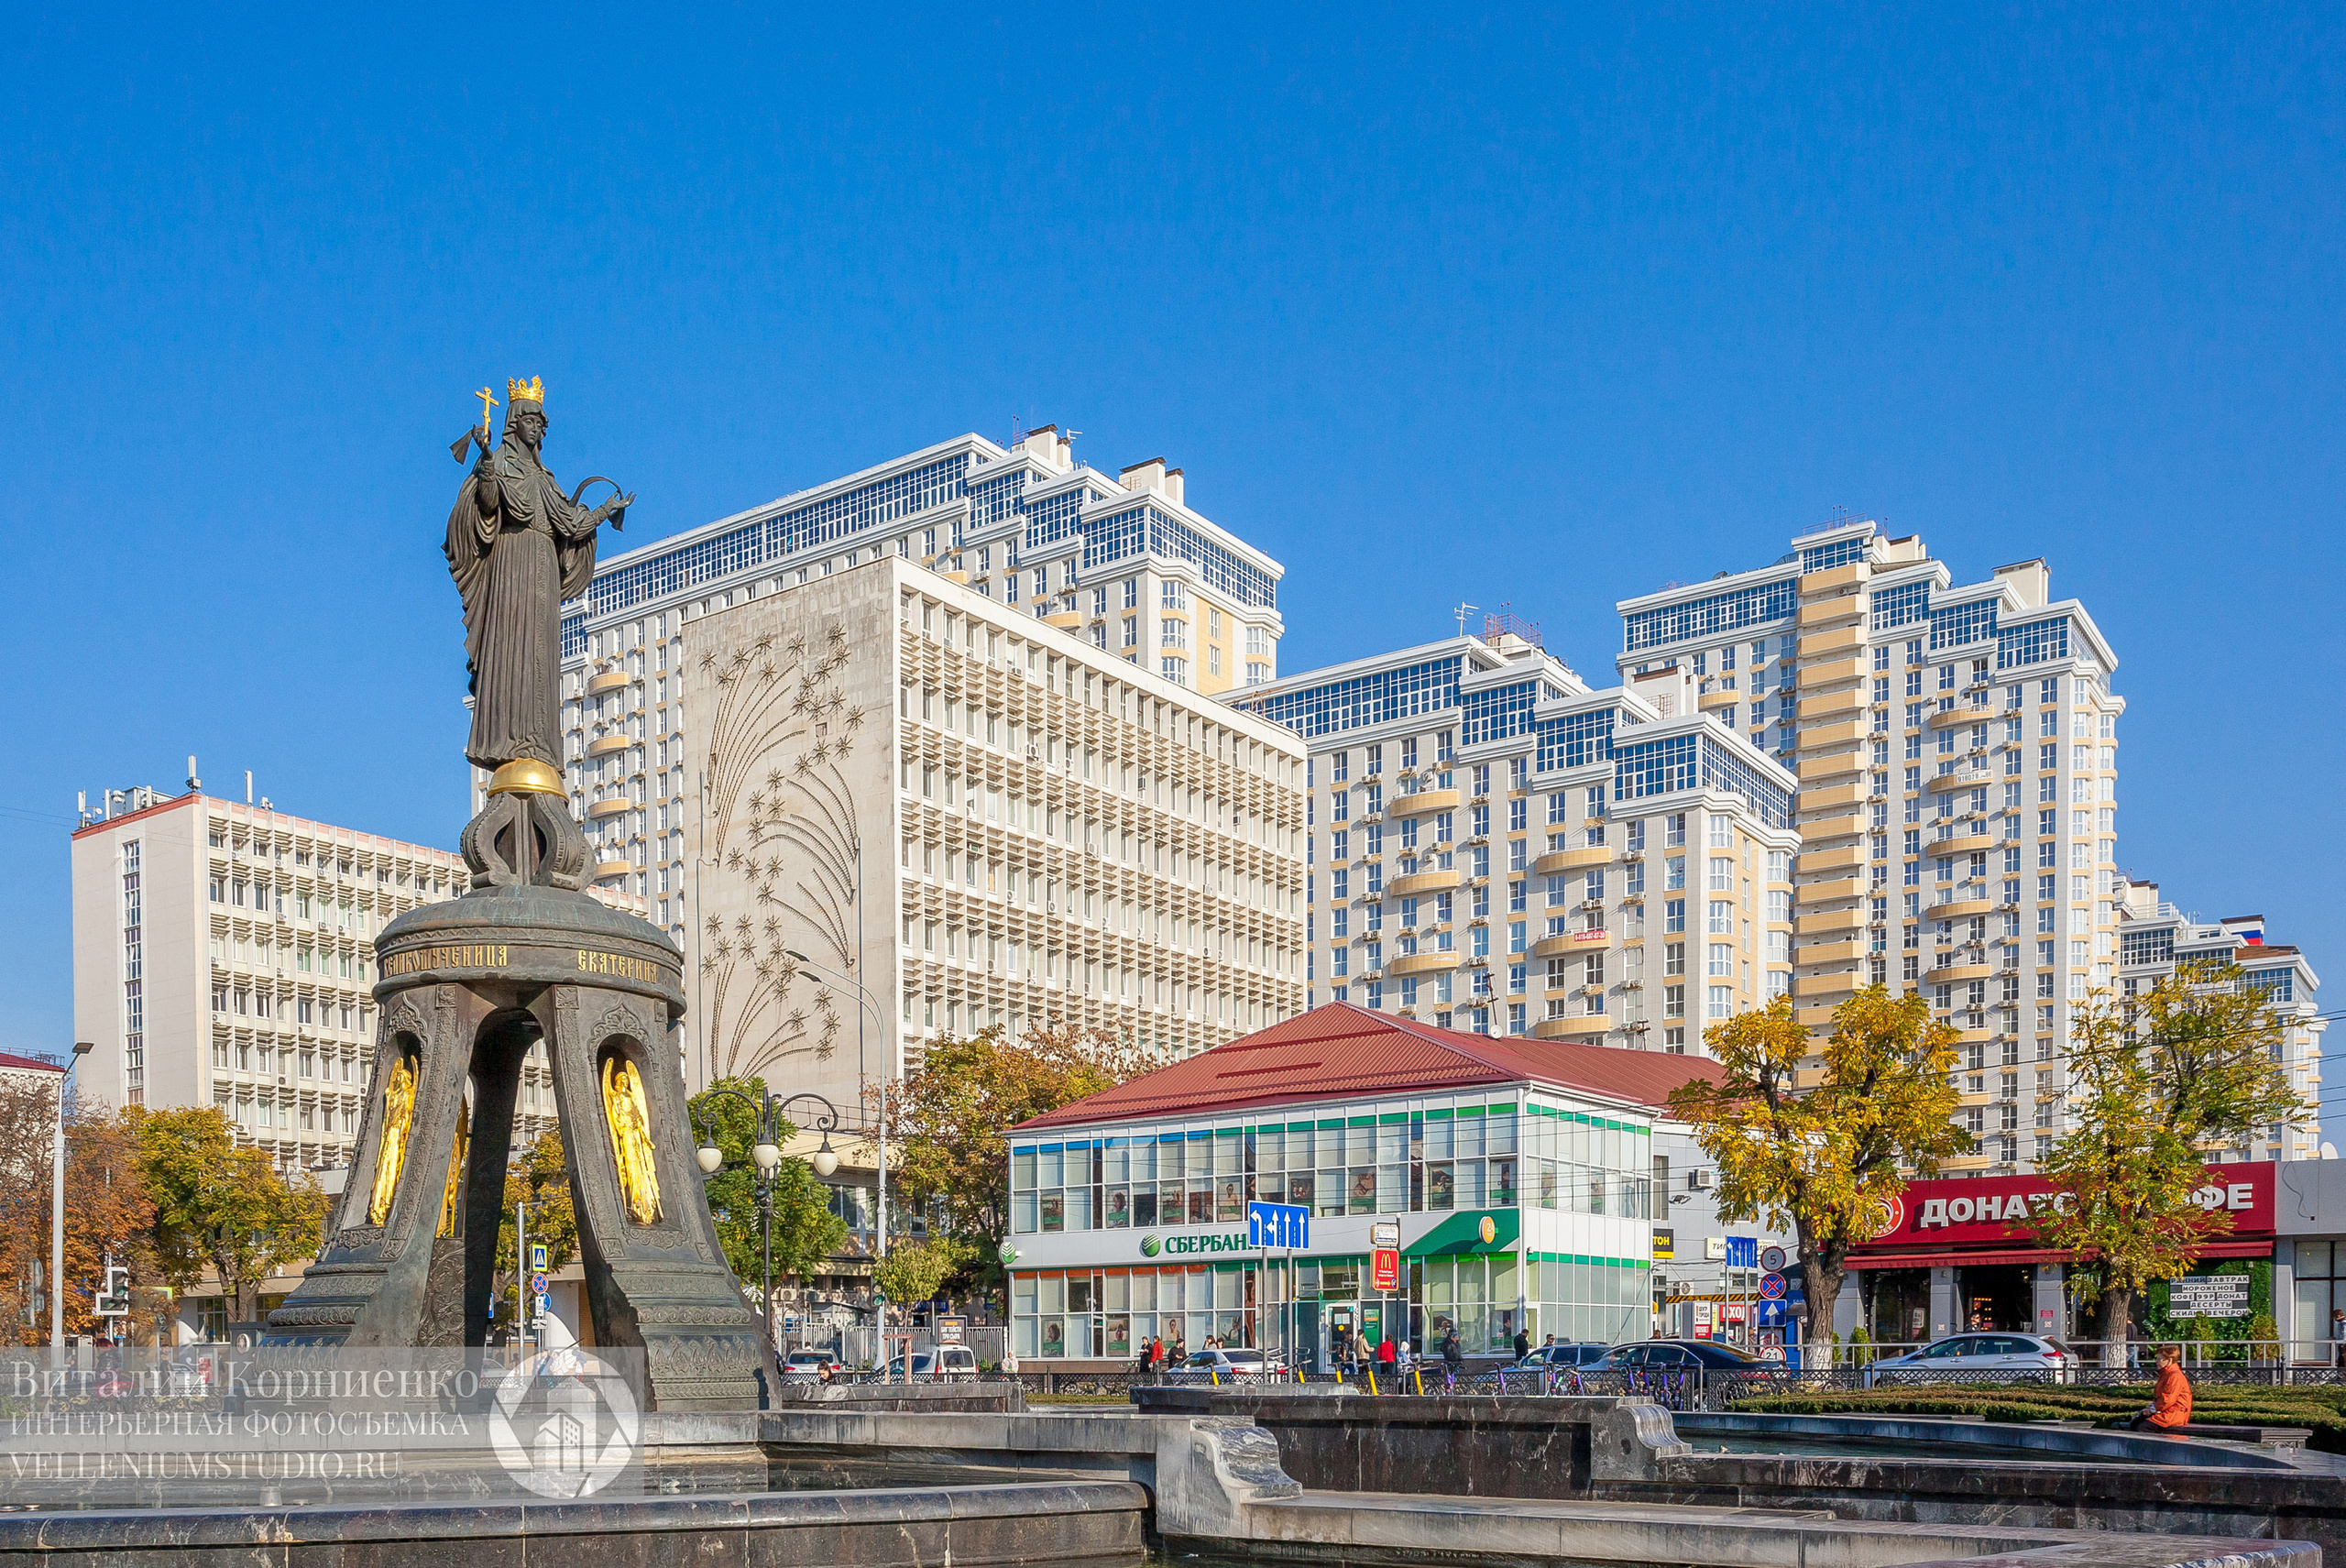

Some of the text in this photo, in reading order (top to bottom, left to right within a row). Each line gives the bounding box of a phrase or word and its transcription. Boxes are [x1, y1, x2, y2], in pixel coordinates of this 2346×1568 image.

[578, 949, 657, 984] ЕКАТЕРИНА
[1165, 1234, 1261, 1254] СБЕРБАН
[1770, 1255, 1777, 1266] 5
